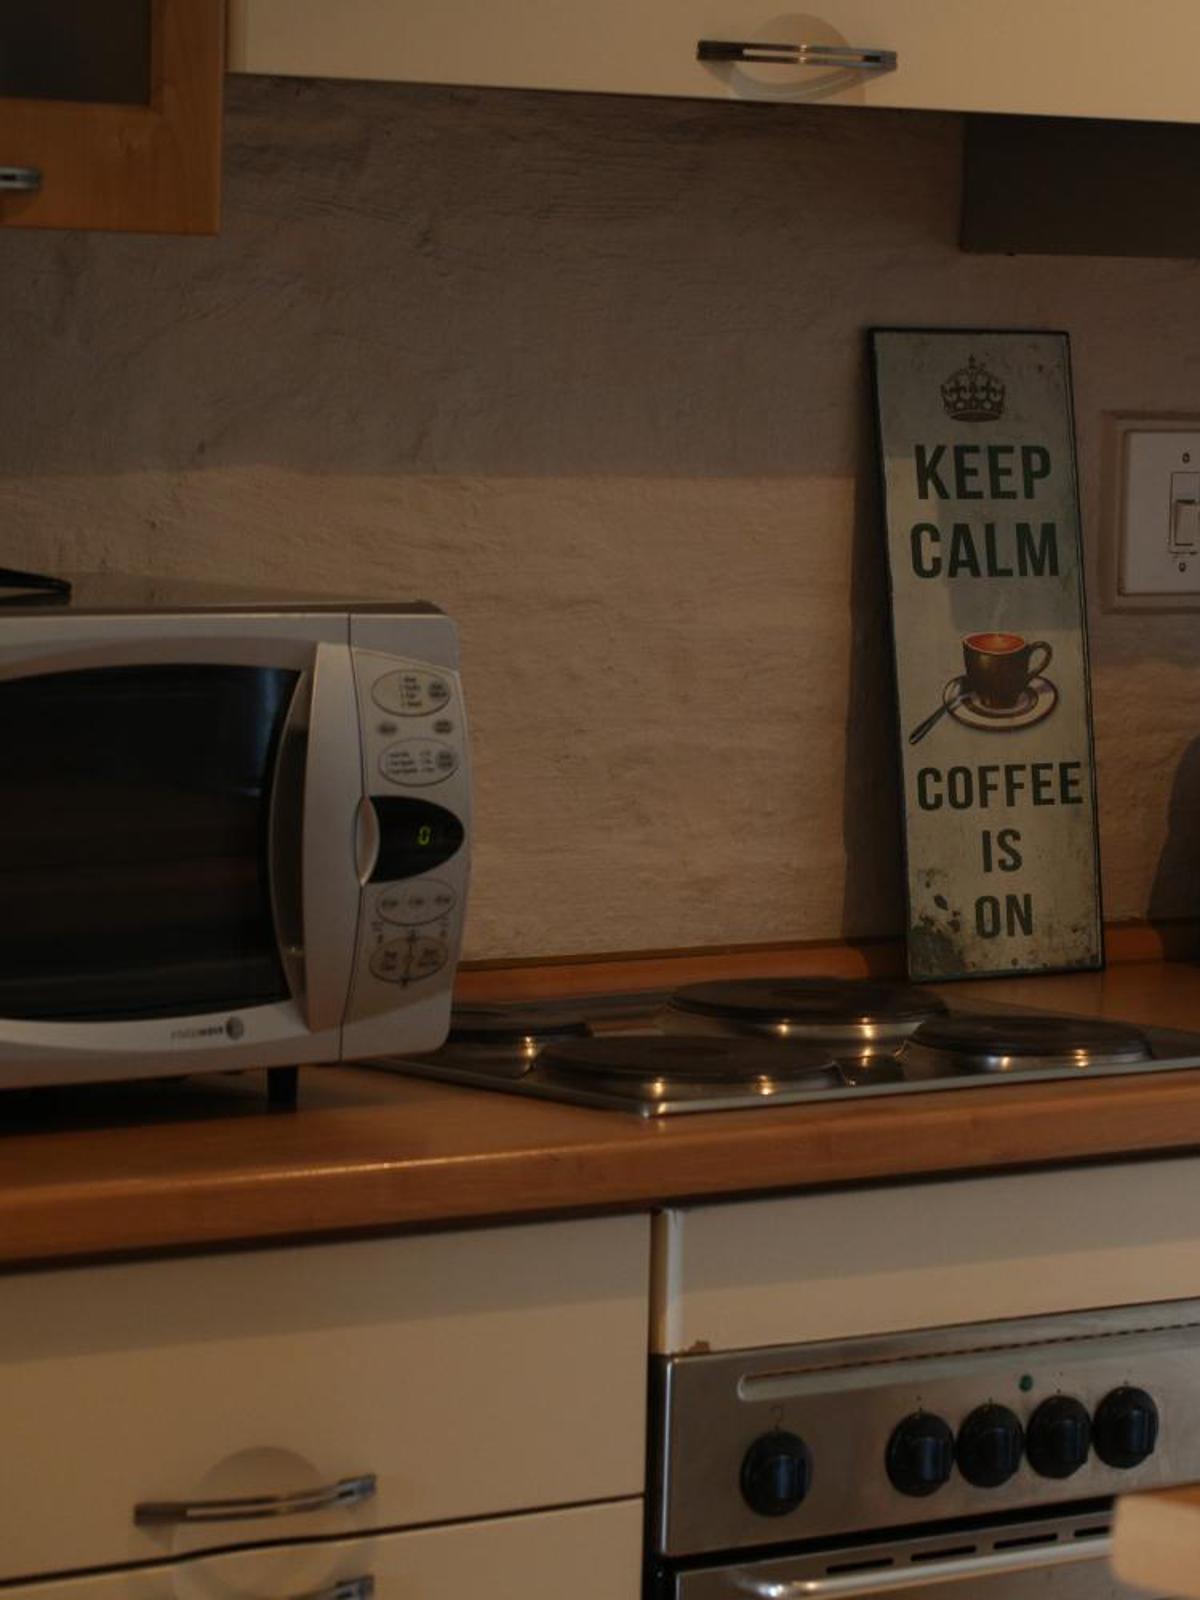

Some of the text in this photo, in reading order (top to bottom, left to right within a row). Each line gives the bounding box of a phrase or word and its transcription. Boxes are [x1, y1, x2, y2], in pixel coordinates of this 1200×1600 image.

[915, 444, 1051, 500] KEEP
[910, 523, 1059, 578] CALM
[917, 761, 1083, 811] COFFEE
[982, 829, 1022, 873] IS
[975, 894, 1033, 939] ON
